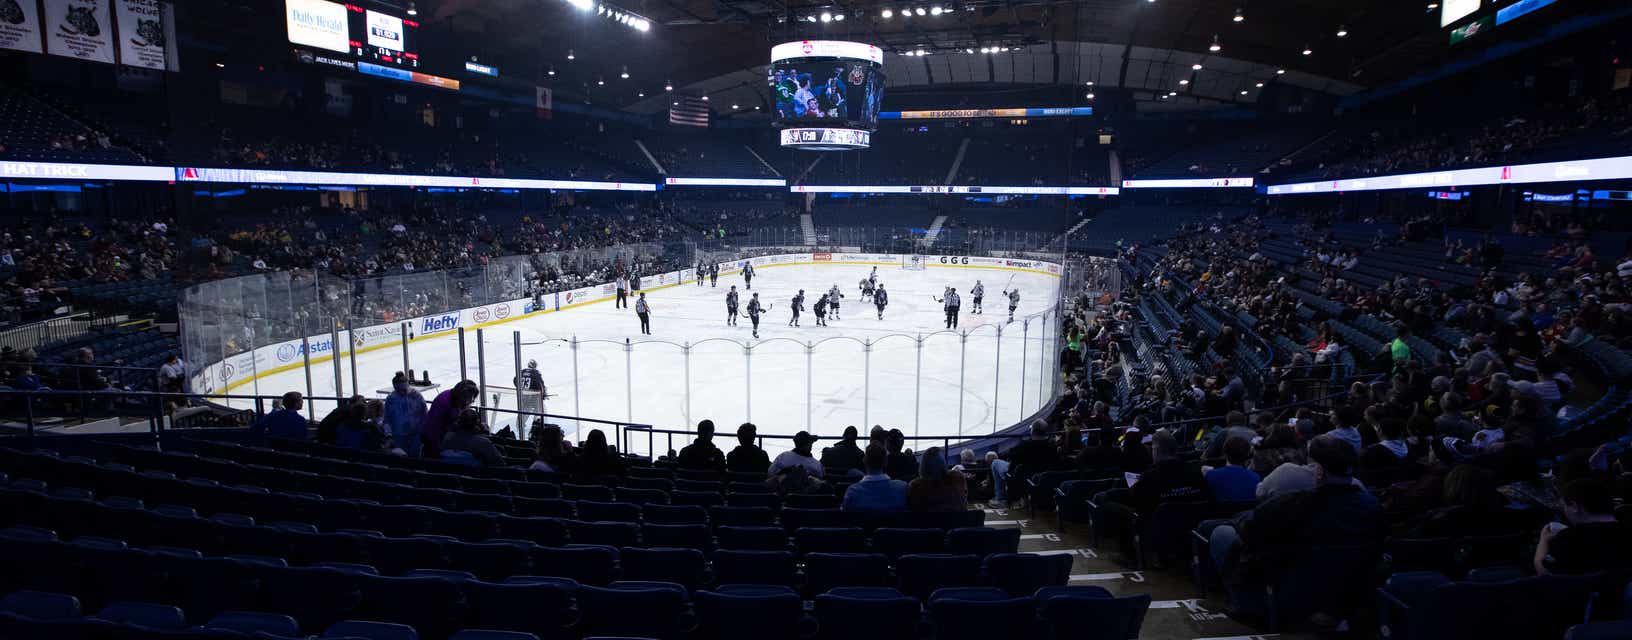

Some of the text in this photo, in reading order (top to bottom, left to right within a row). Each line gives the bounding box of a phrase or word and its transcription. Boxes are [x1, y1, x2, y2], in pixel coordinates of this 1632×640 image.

[290, 9, 313, 25] Daily
[315, 15, 343, 32] Herald
[4, 163, 88, 177] HAT TRICK
[941, 256, 948, 264] G
[951, 257, 958, 265] G
[961, 257, 969, 265] G
[424, 315, 457, 331] Hefty
[1045, 533, 1062, 542] G
[1079, 548, 1098, 558] H
[1129, 571, 1145, 582] J
[1183, 599, 1209, 612] K
